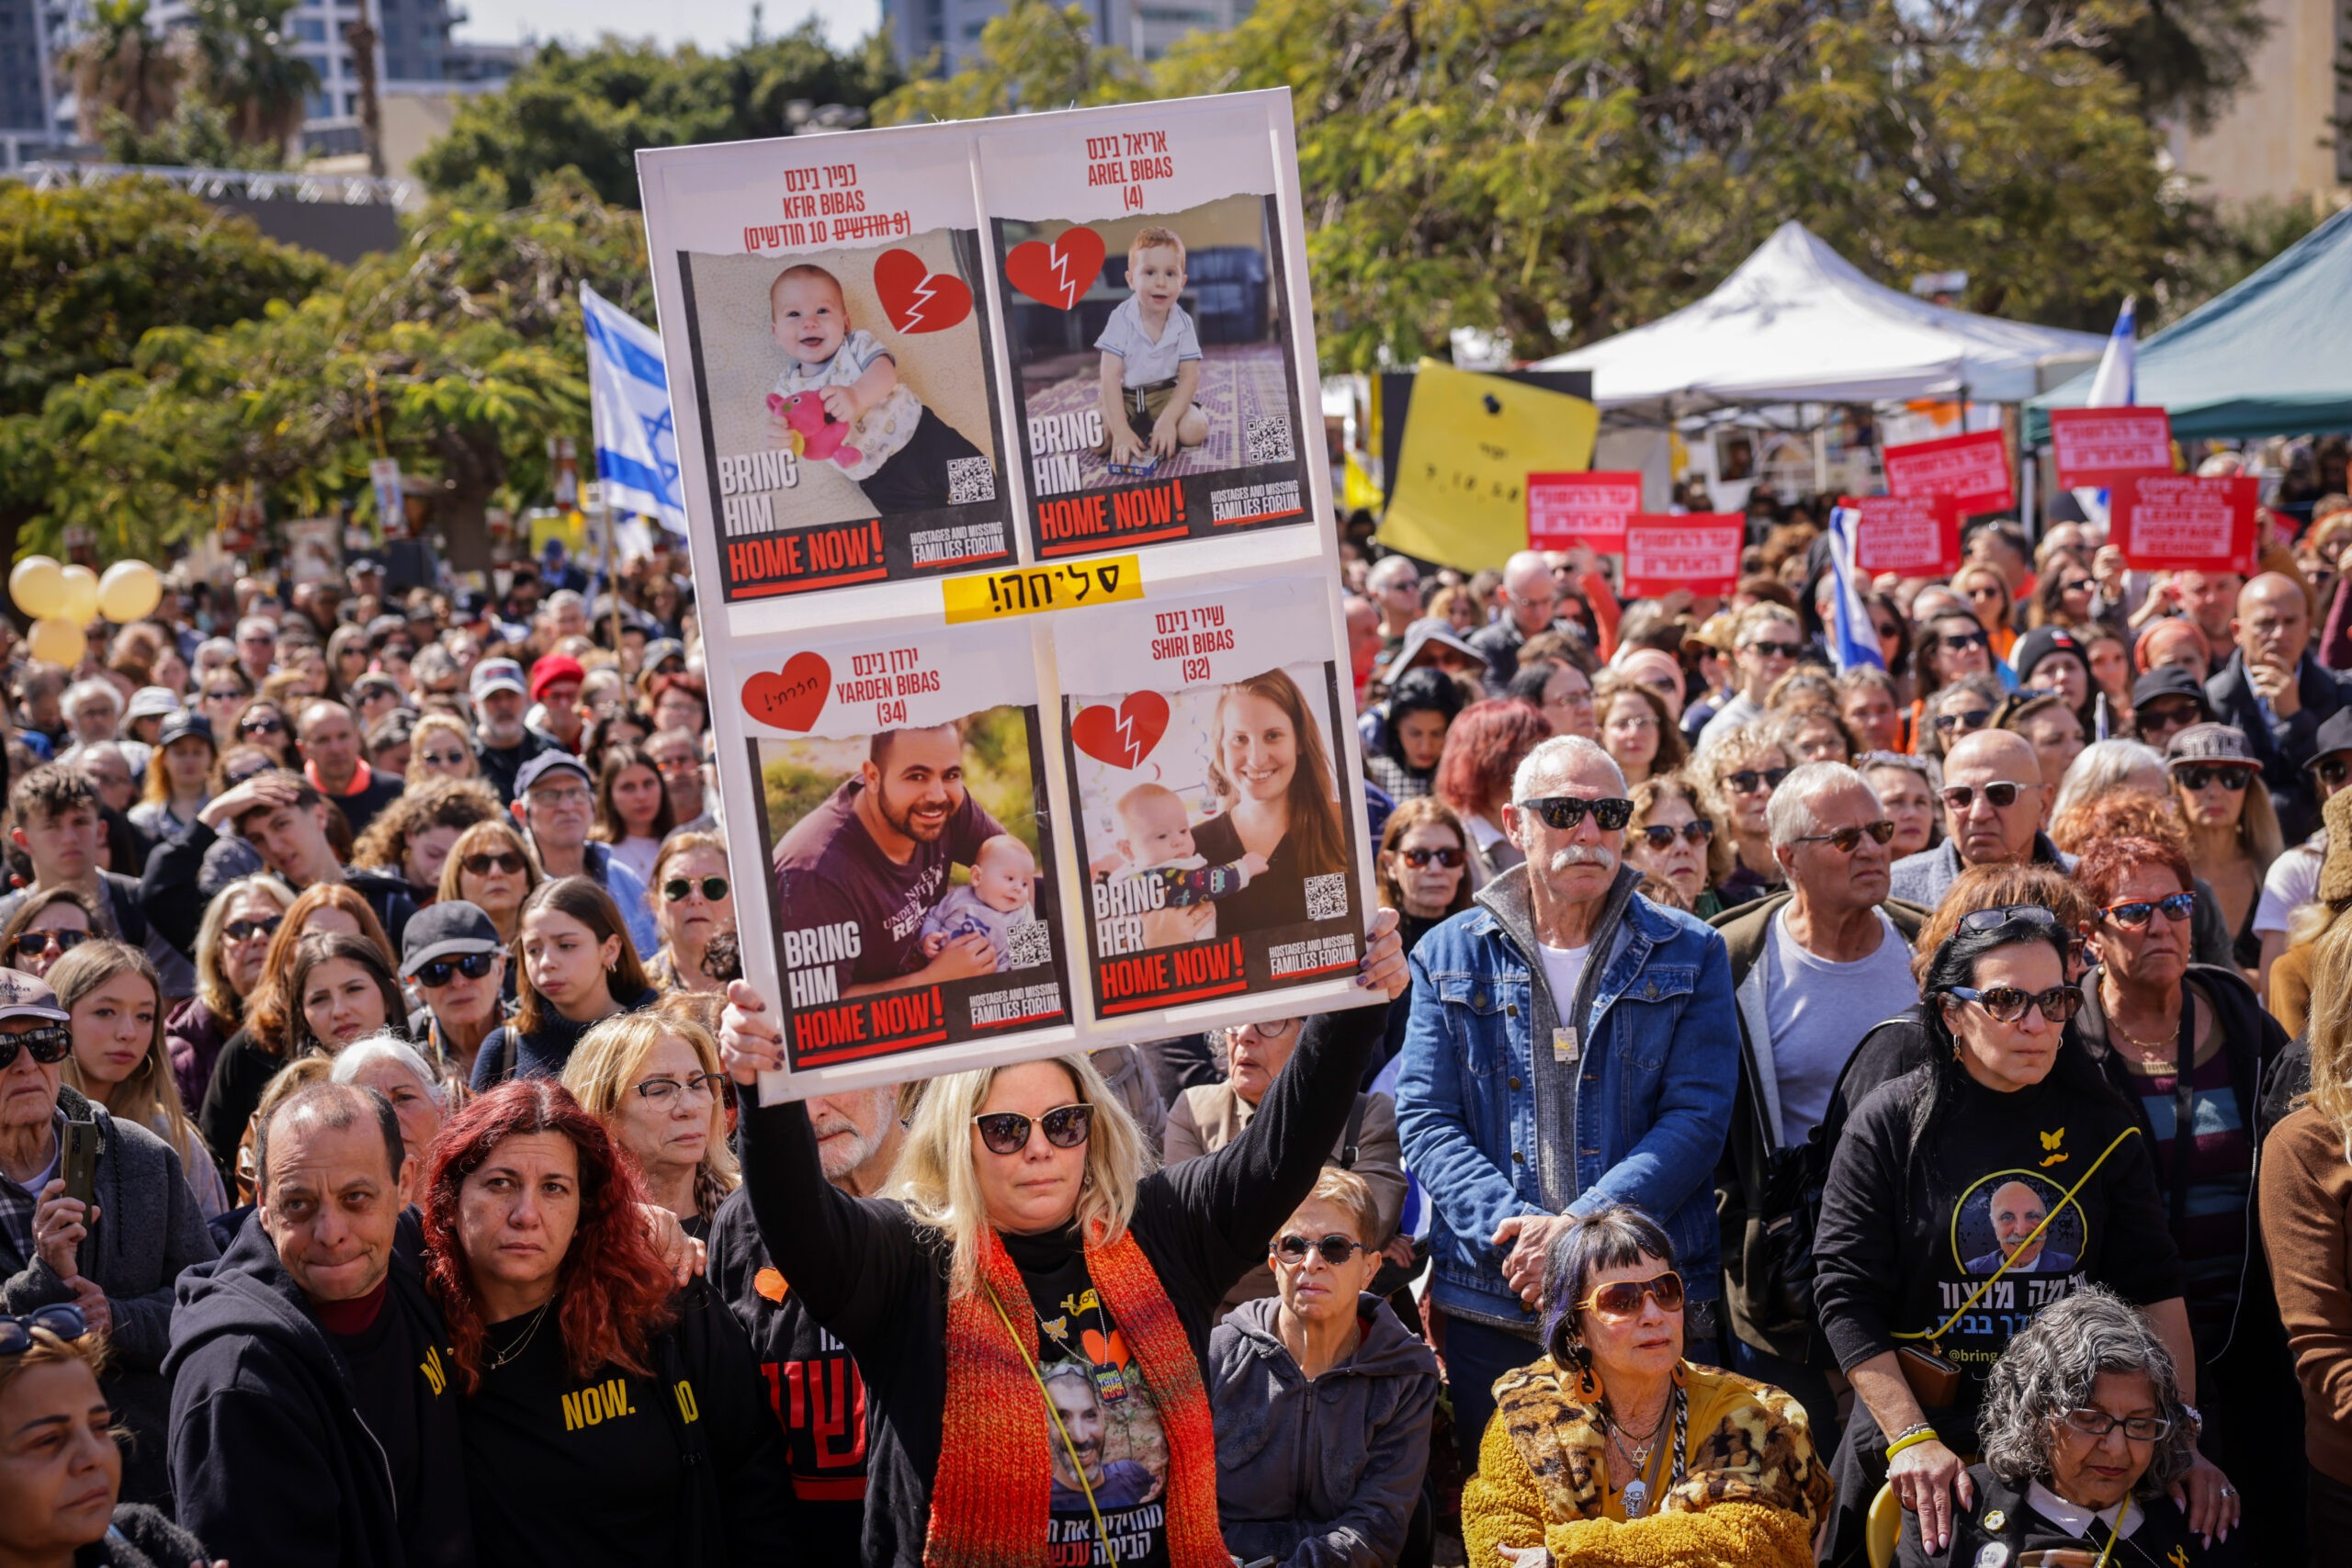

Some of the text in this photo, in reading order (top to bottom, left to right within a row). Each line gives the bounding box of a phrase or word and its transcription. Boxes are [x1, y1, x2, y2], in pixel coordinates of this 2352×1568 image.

[1086, 130, 1168, 160] אריאל ביבס
[784, 164, 857, 192] כפיר ביבס
[1089, 156, 1173, 186] ARIEL BIBAS
[783, 190, 865, 220] KFIR BIBAS
[1124, 184, 1143, 211] (4)
[809, 220, 827, 243] 10
[1028, 411, 1103, 455] BRING
[720, 448, 797, 494] BRING
[1032, 454, 1082, 496] HIM
[1211, 479, 1298, 503] HOSTAGES AND MISSING
[1213, 492, 1300, 521] FAMILIES FORUM
[723, 495, 775, 536] HIM
[1038, 479, 1186, 540] HOME NOW!
[910, 522, 1003, 545] HOSTAGES AND MISSING
[912, 535, 1005, 563] FAMILIES FORUM
[728, 520, 885, 581] HOME NOW!
[988, 565, 1119, 613] סליחה!
[1155, 605, 1225, 635] שירי ביבס
[1151, 628, 1235, 660] SHIRI BIBAS
[852, 648, 919, 677] ירדן ביבס
[1182, 656, 1210, 683] (32)
[836, 670, 941, 705] YARDEN BIBAS
[876, 699, 907, 727] (34)
[1092, 874, 1167, 919] BRING
[784, 920, 862, 969] BRING
[1096, 918, 1146, 958] HER
[1269, 933, 1354, 959] HOSTAGES AND MISSING
[1100, 936, 1245, 999] HOME NOW!
[1271, 945, 1357, 976] FAMILIES FORUM
[788, 965, 839, 1009] HIM
[969, 982, 1059, 1008] HOSTAGES AND MISSING
[794, 986, 944, 1051] HOME NOW!
[971, 994, 1061, 1025] FAMILIES FORUM
[561, 1379, 636, 1431] NOW.
[1062, 1519, 1090, 1542] את
[1094, 1504, 1163, 1540] מחזירים
[1049, 1541, 1090, 1567] עכש
